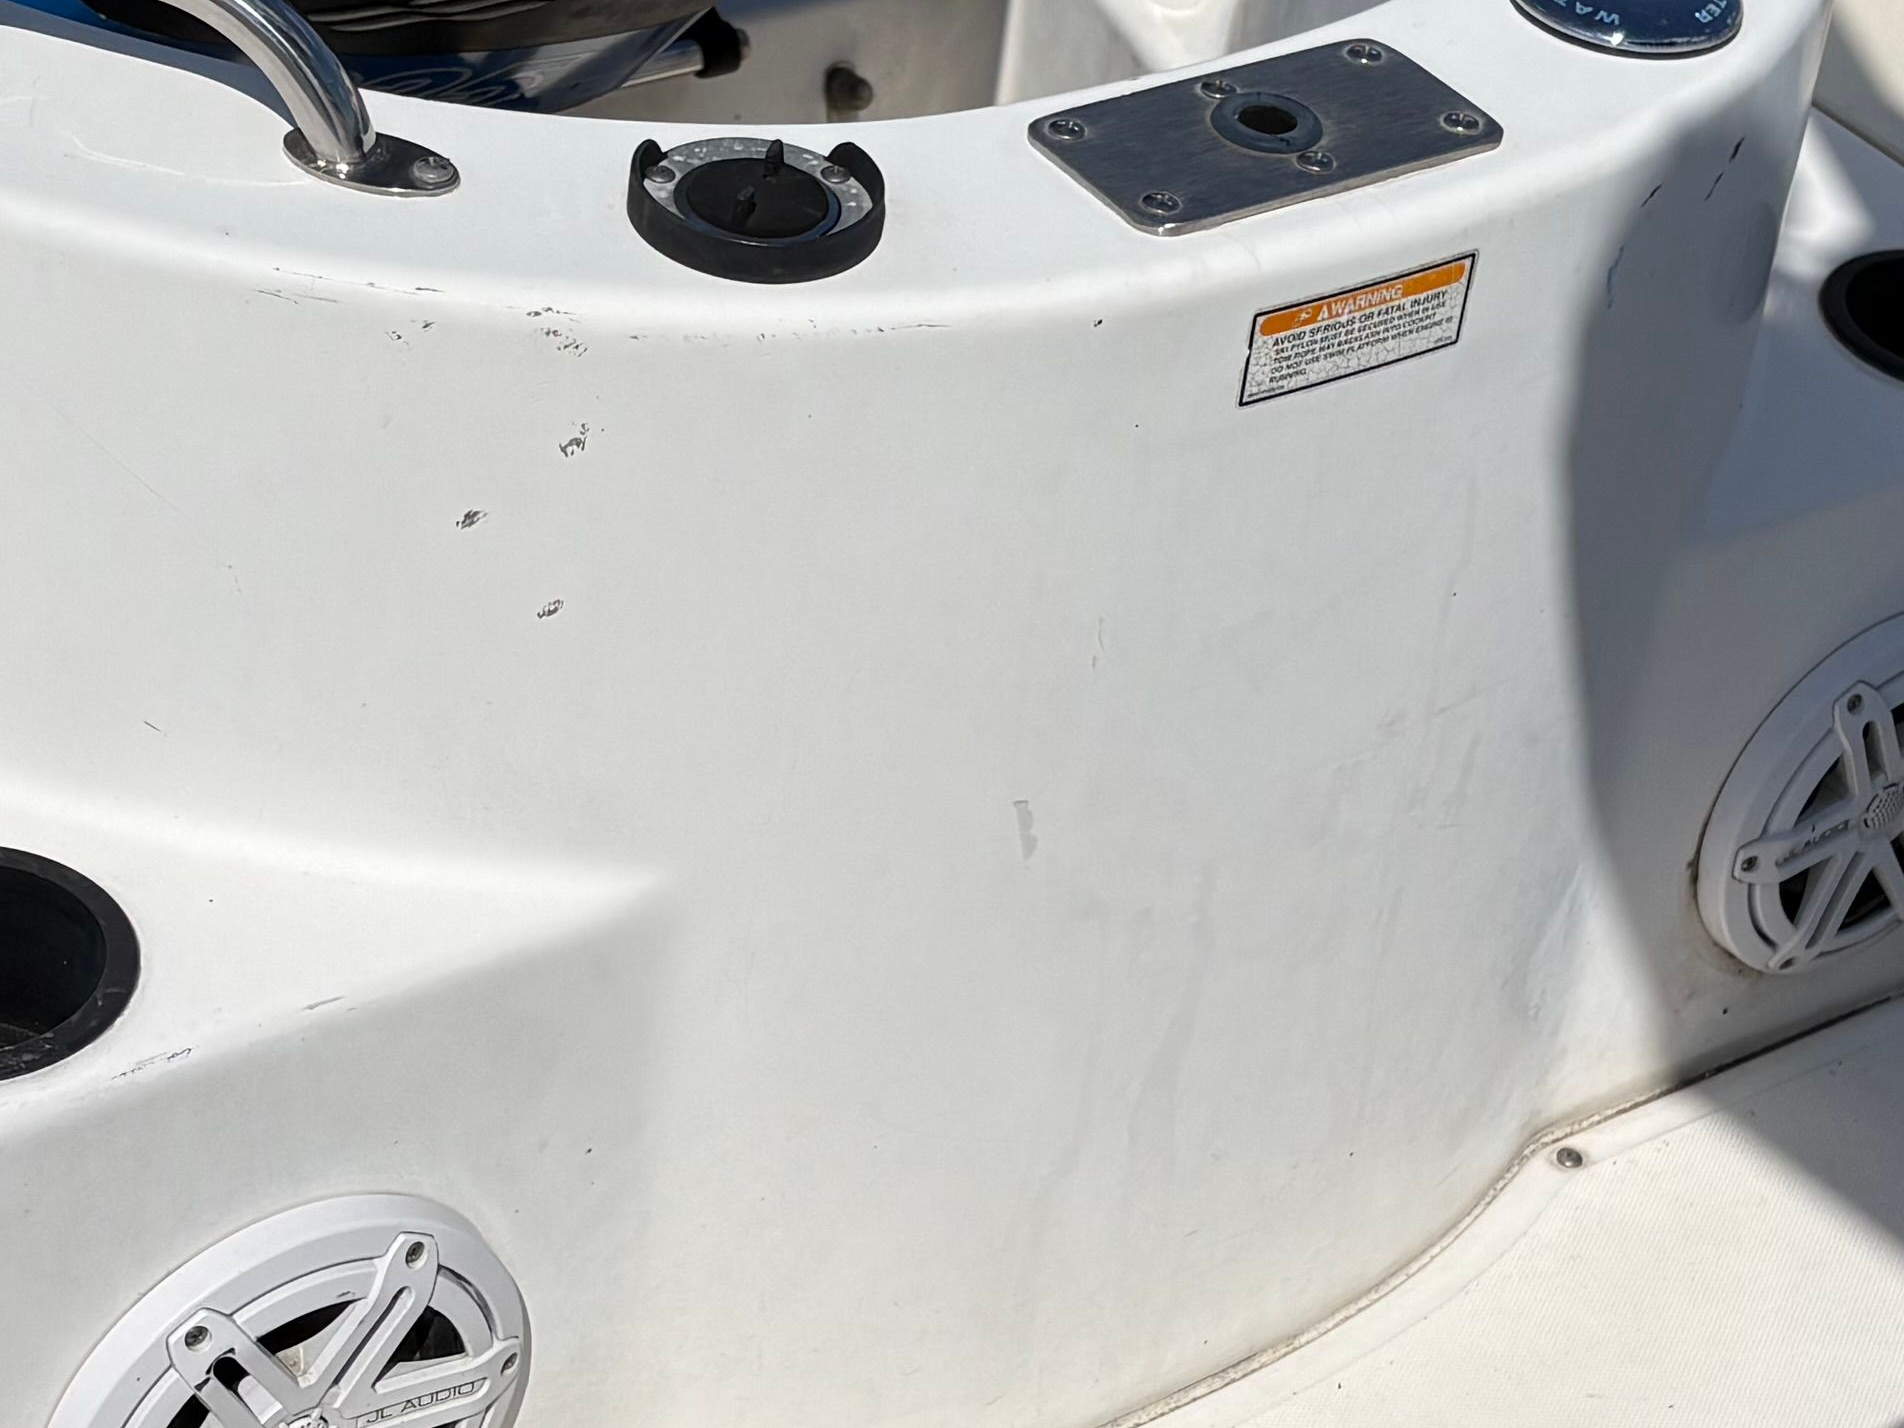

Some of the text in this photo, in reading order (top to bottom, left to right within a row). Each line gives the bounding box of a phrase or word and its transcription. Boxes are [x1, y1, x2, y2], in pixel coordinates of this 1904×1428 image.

[1271, 328, 1307, 349] AVOID
[1307, 314, 1357, 339] SERIOUS
[1376, 300, 1407, 318] FATAL
[1409, 288, 1448, 309] INJURY
[1330, 284, 1404, 317] WARNING
[1285, 358, 1303, 371] NOT
[1346, 333, 1391, 354] PLATFORM
[366, 1381, 475, 1423] JL AUDIO
